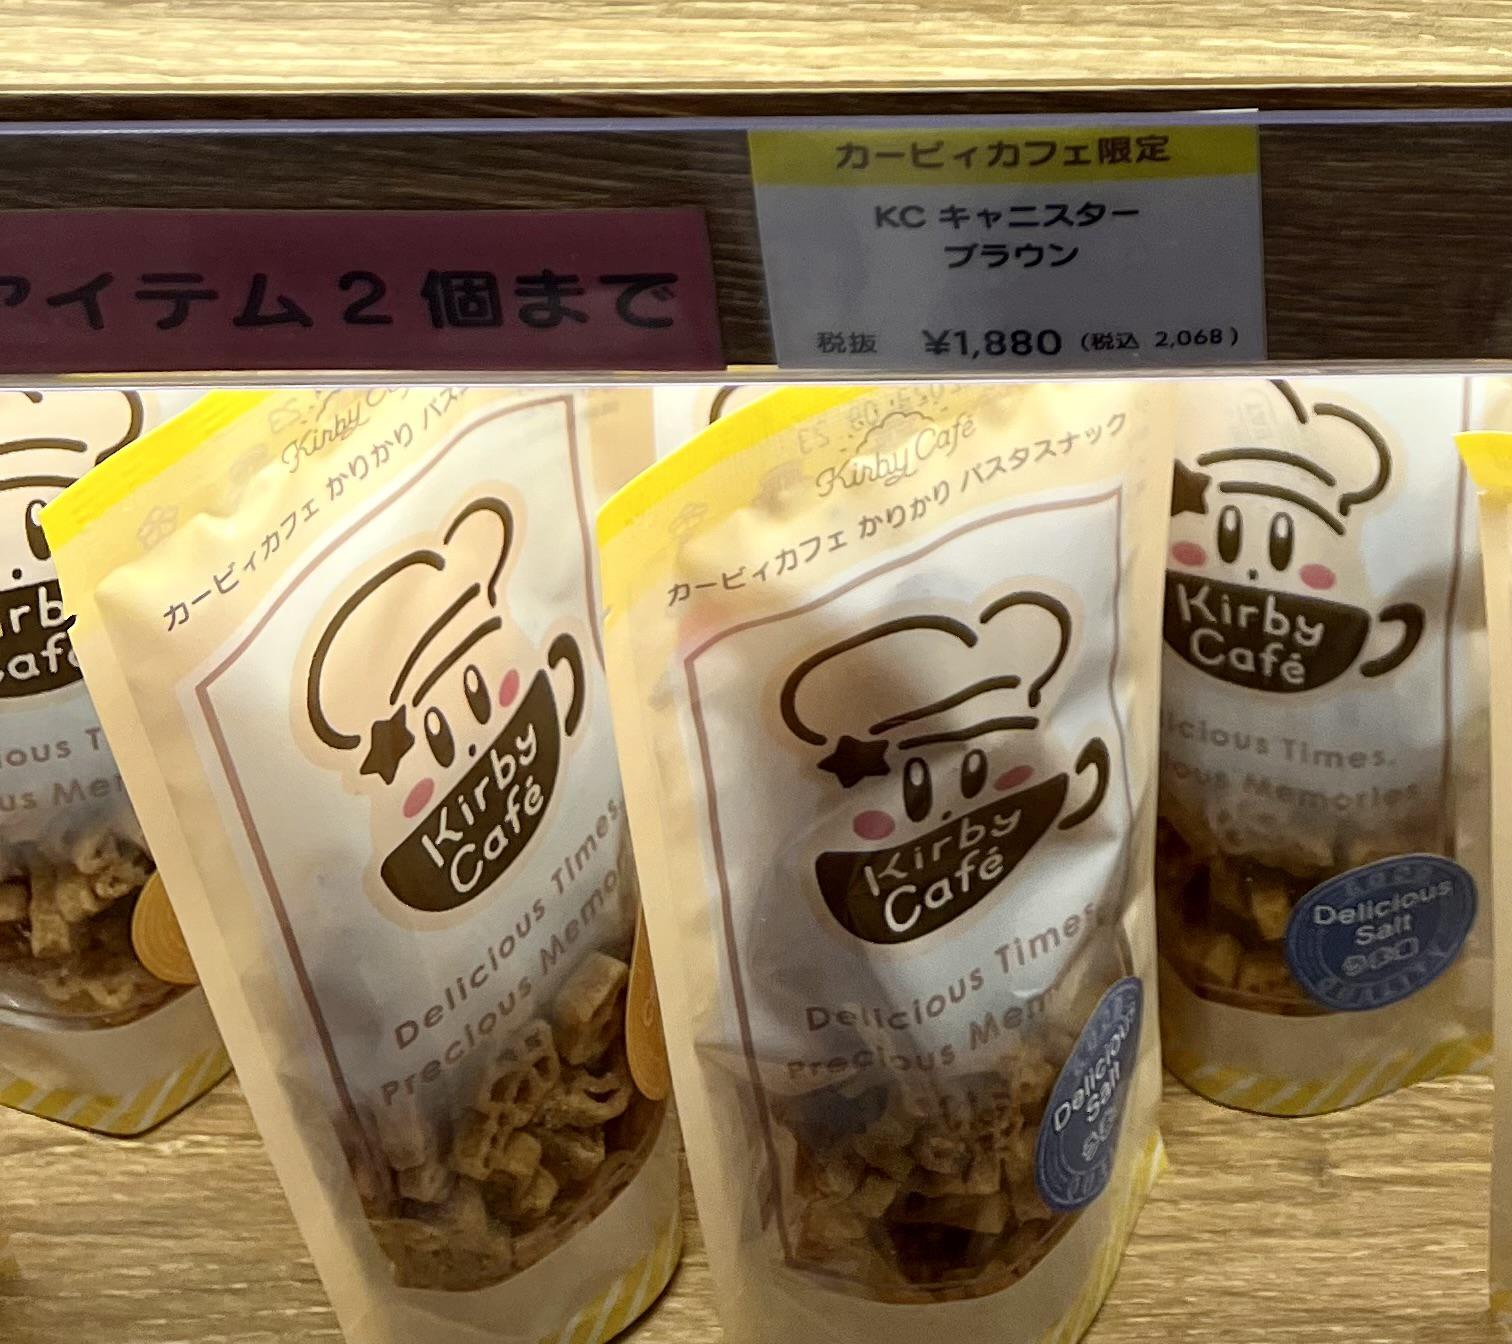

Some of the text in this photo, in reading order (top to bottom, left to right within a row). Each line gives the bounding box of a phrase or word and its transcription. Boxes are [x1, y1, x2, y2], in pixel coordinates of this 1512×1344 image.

[836, 135, 1172, 170] カービィカフェ限定
[874, 201, 1140, 230] KC キャニスター
[943, 243, 1080, 270] ブラウン
[816, 330, 879, 355] 税抜
[921, 327, 1063, 360] ¥1,880
[325, 422, 415, 500] かりかり
[815, 414, 978, 499] Kirby Café
[667, 411, 1128, 609] カービィカフェ かりかり パスタスナック
[1173, 580, 1326, 650] Kirby
[1188, 626, 1308, 688] Café
[420, 720, 538, 869] Kirby
[449, 775, 546, 894] Café
[863, 807, 1023, 897] Kirby
[882, 845, 1006, 934] Café
[1312, 878, 1453, 928] Delicious
[1353, 912, 1414, 947] Salt
[394, 896, 547, 1052] Delicious
[805, 964, 985, 1034] Delicious
[379, 977, 533, 1108] Precious
